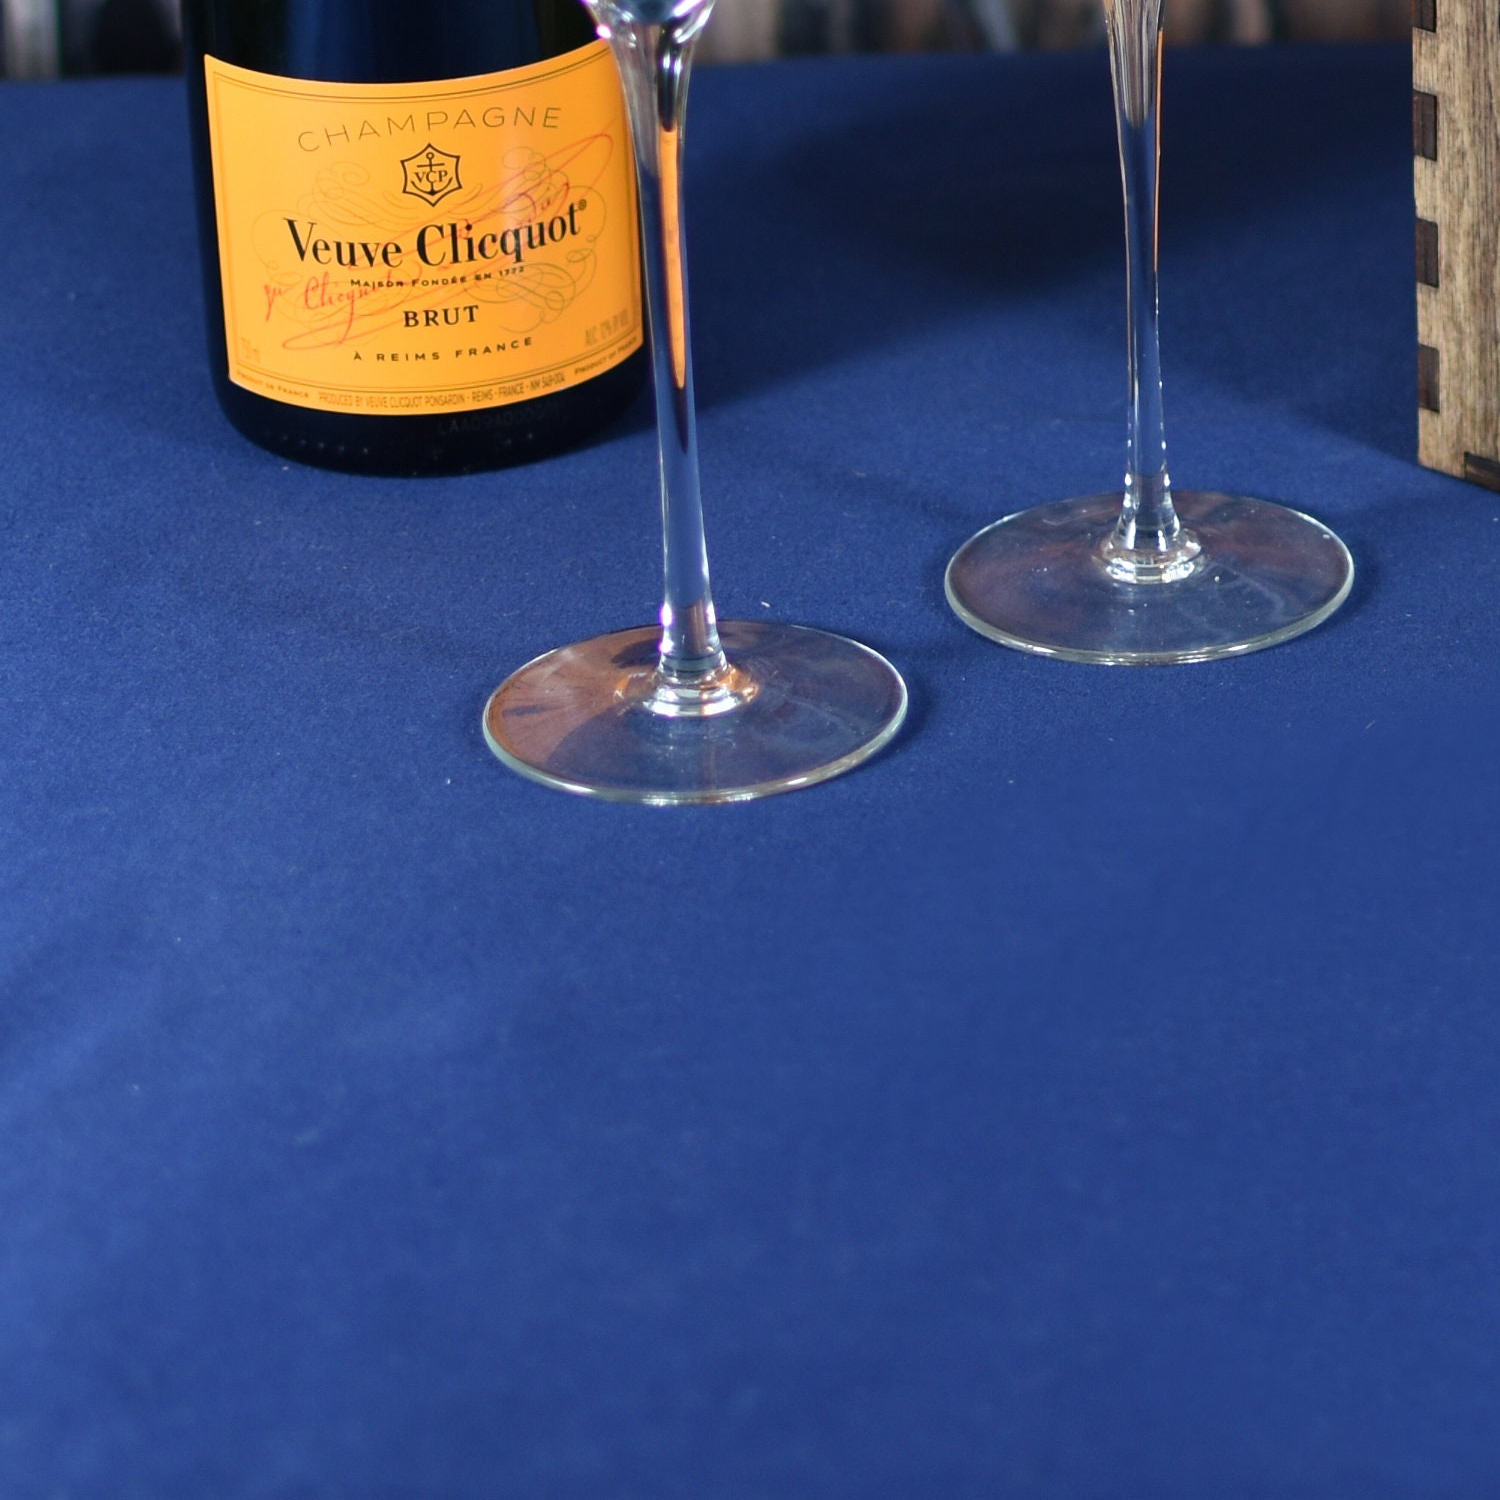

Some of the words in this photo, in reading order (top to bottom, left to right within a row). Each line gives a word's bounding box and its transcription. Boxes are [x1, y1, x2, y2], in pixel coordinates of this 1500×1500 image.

[297, 106, 562, 152] CHAMPAGNE
[282, 217, 404, 269] Veuve
[403, 304, 480, 328] BRUT
[353, 350, 363, 361] À
[376, 351, 441, 362] REIMS
[455, 336, 533, 359] FRANCE
